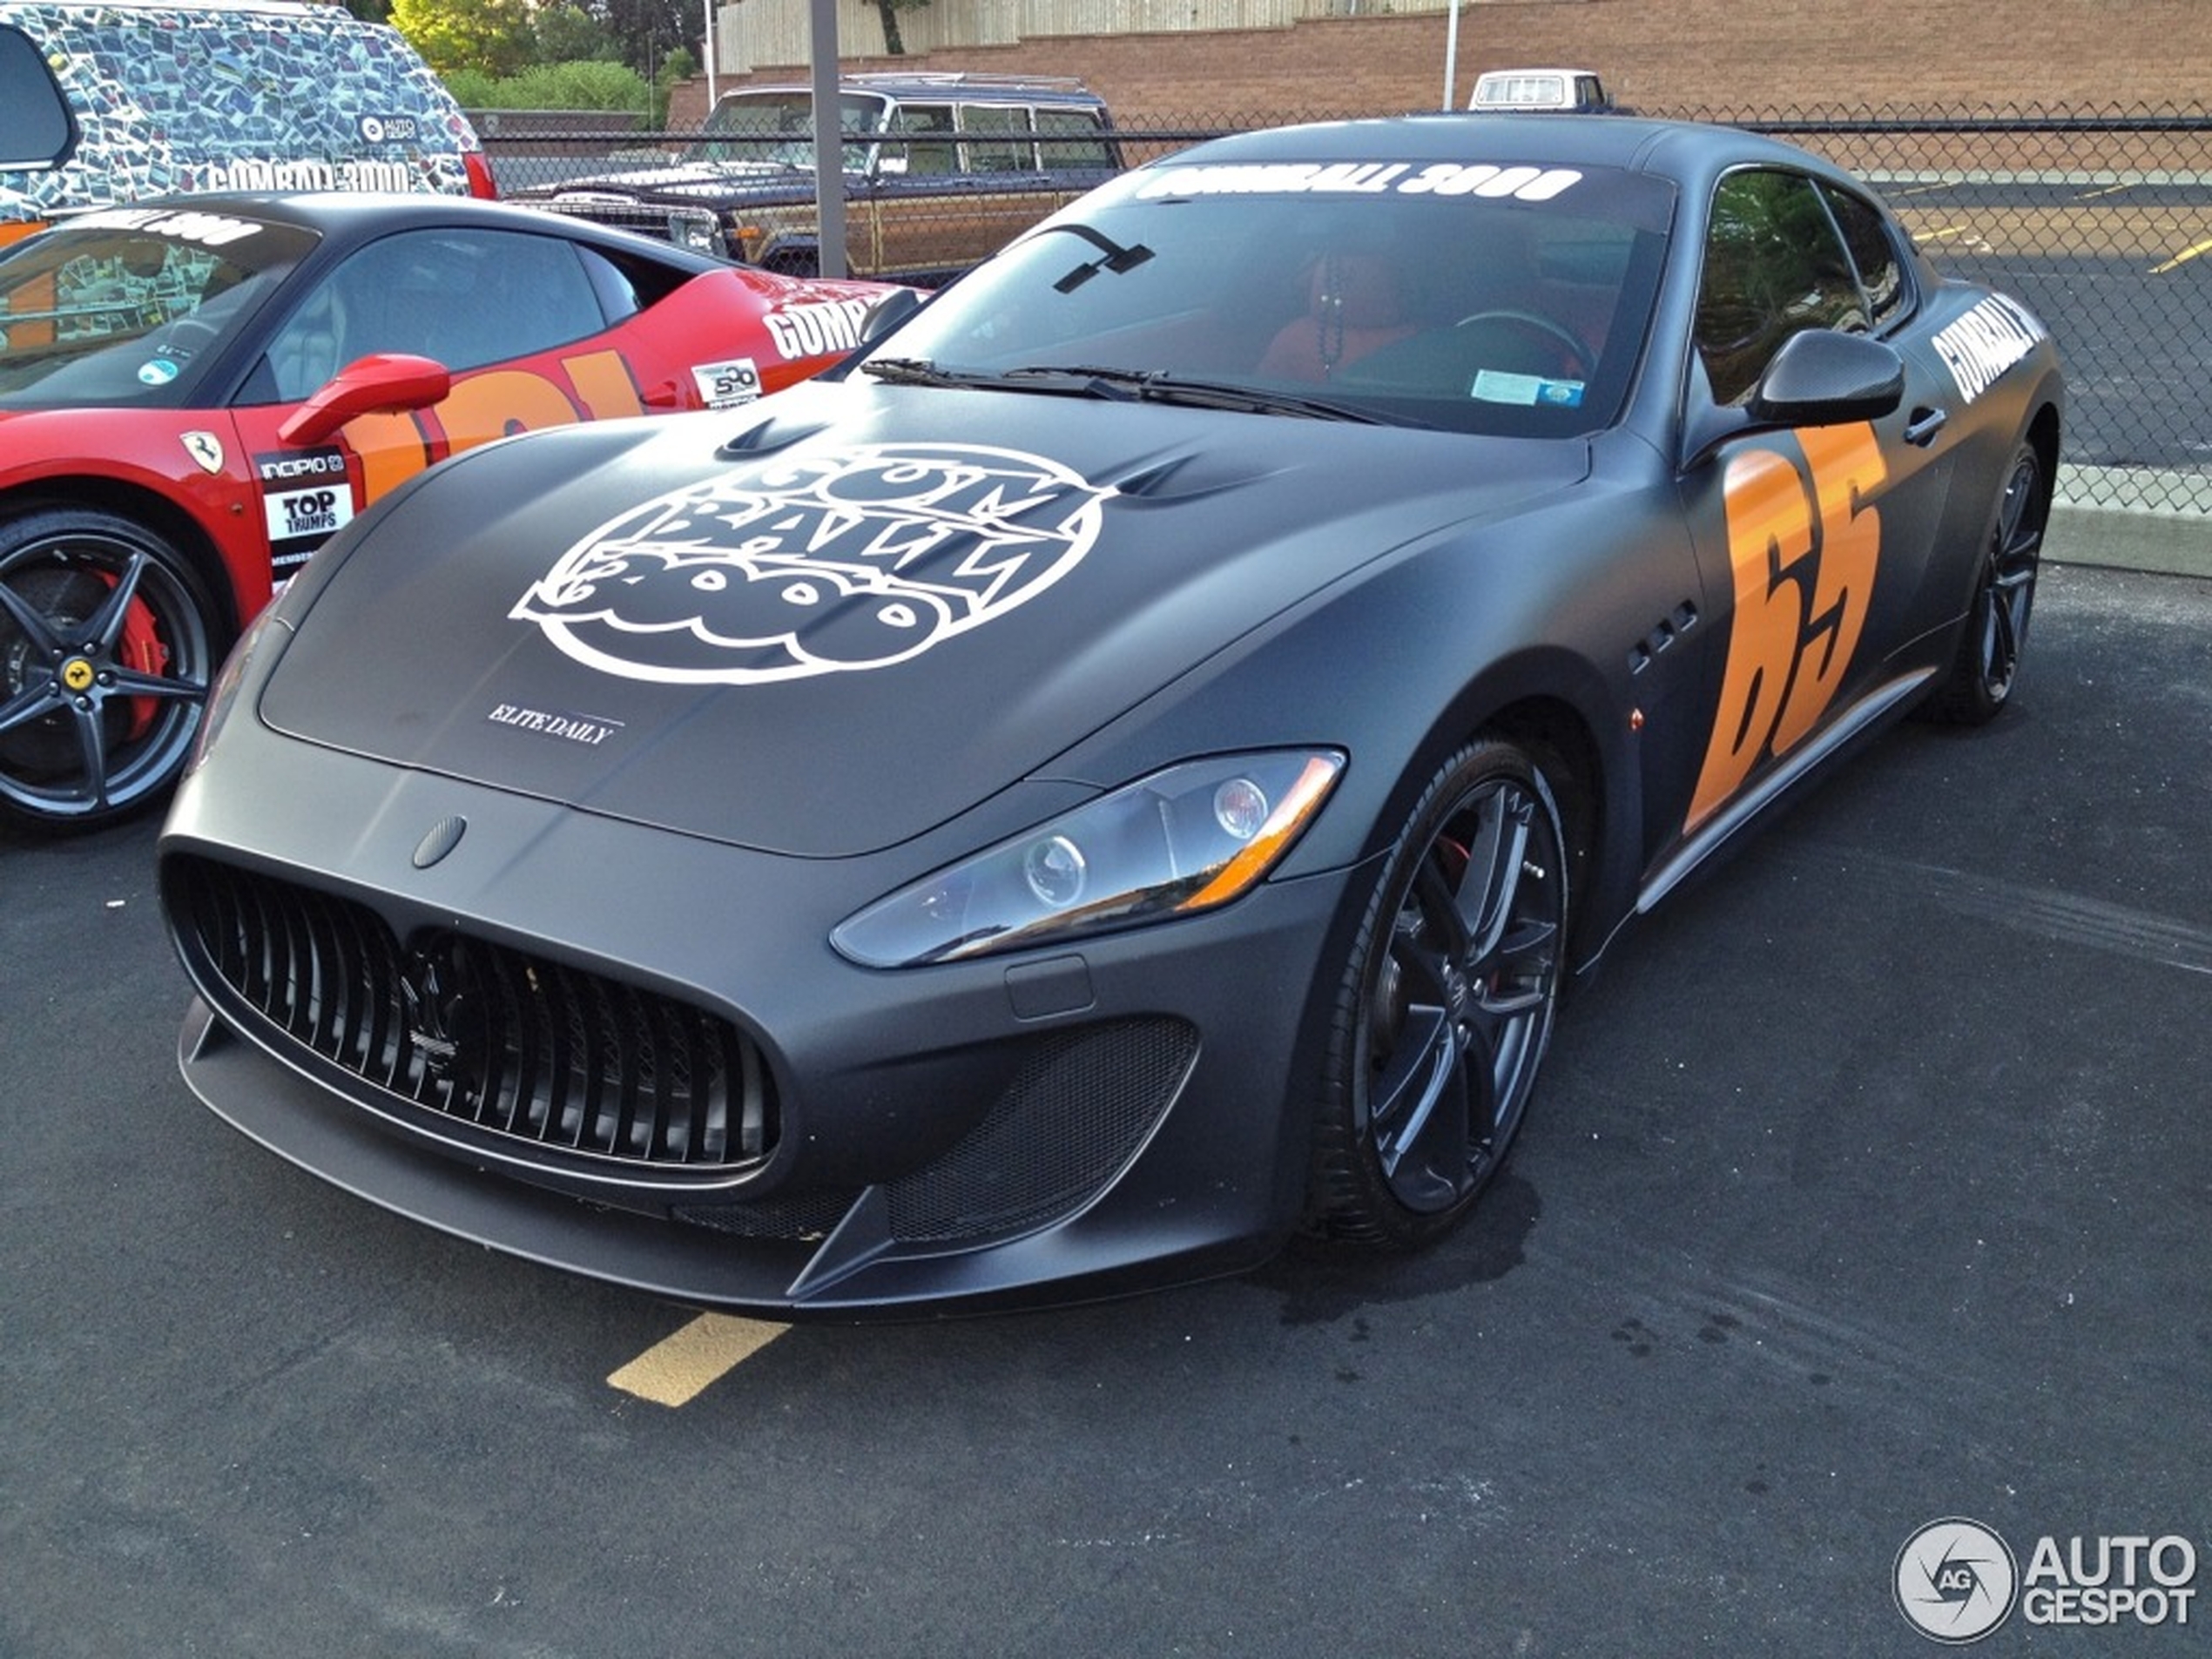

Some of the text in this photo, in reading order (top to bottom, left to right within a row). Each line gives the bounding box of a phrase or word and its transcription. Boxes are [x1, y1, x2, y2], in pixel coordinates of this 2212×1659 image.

[384, 118, 415, 131] AUTO
[207, 159, 336, 192] GUMBALL
[1397, 163, 1583, 201] 3000
[763, 299, 873, 360] GUMB
[283, 490, 335, 519] TOP
[286, 512, 337, 534] TRUMPS
[1683, 421, 1887, 835] 65
[489, 704, 614, 745] ELITE DAILY
